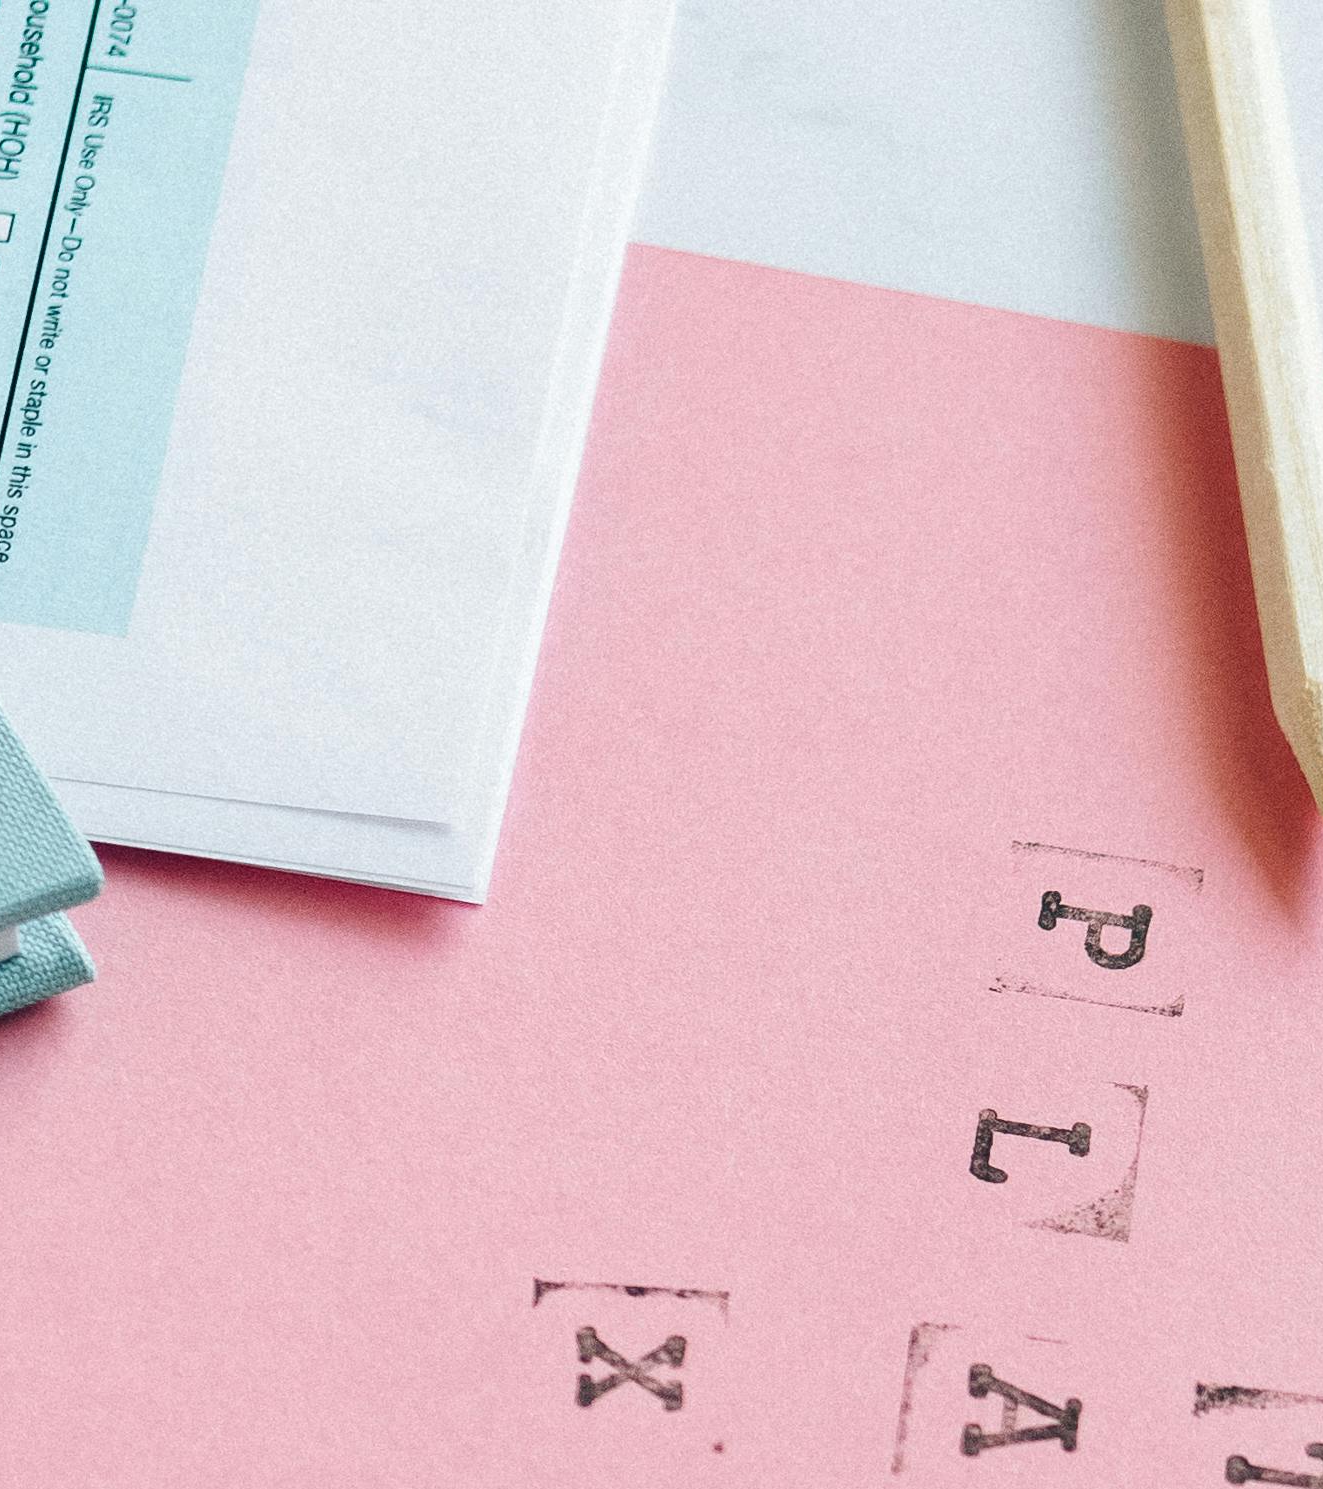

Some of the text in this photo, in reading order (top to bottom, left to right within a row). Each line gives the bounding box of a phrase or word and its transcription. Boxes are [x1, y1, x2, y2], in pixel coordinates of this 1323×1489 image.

[88, 94, 114, 128] IRS
[78, 134, 105, 170] Use
[51, 269, 71, 300] not
[39, 304, 63, 349] write
[35, 356, 52, 374] or
[20, 379, 48, 436] staple
[15, 442, 39, 460] in
[7, 465, 32, 498] this
